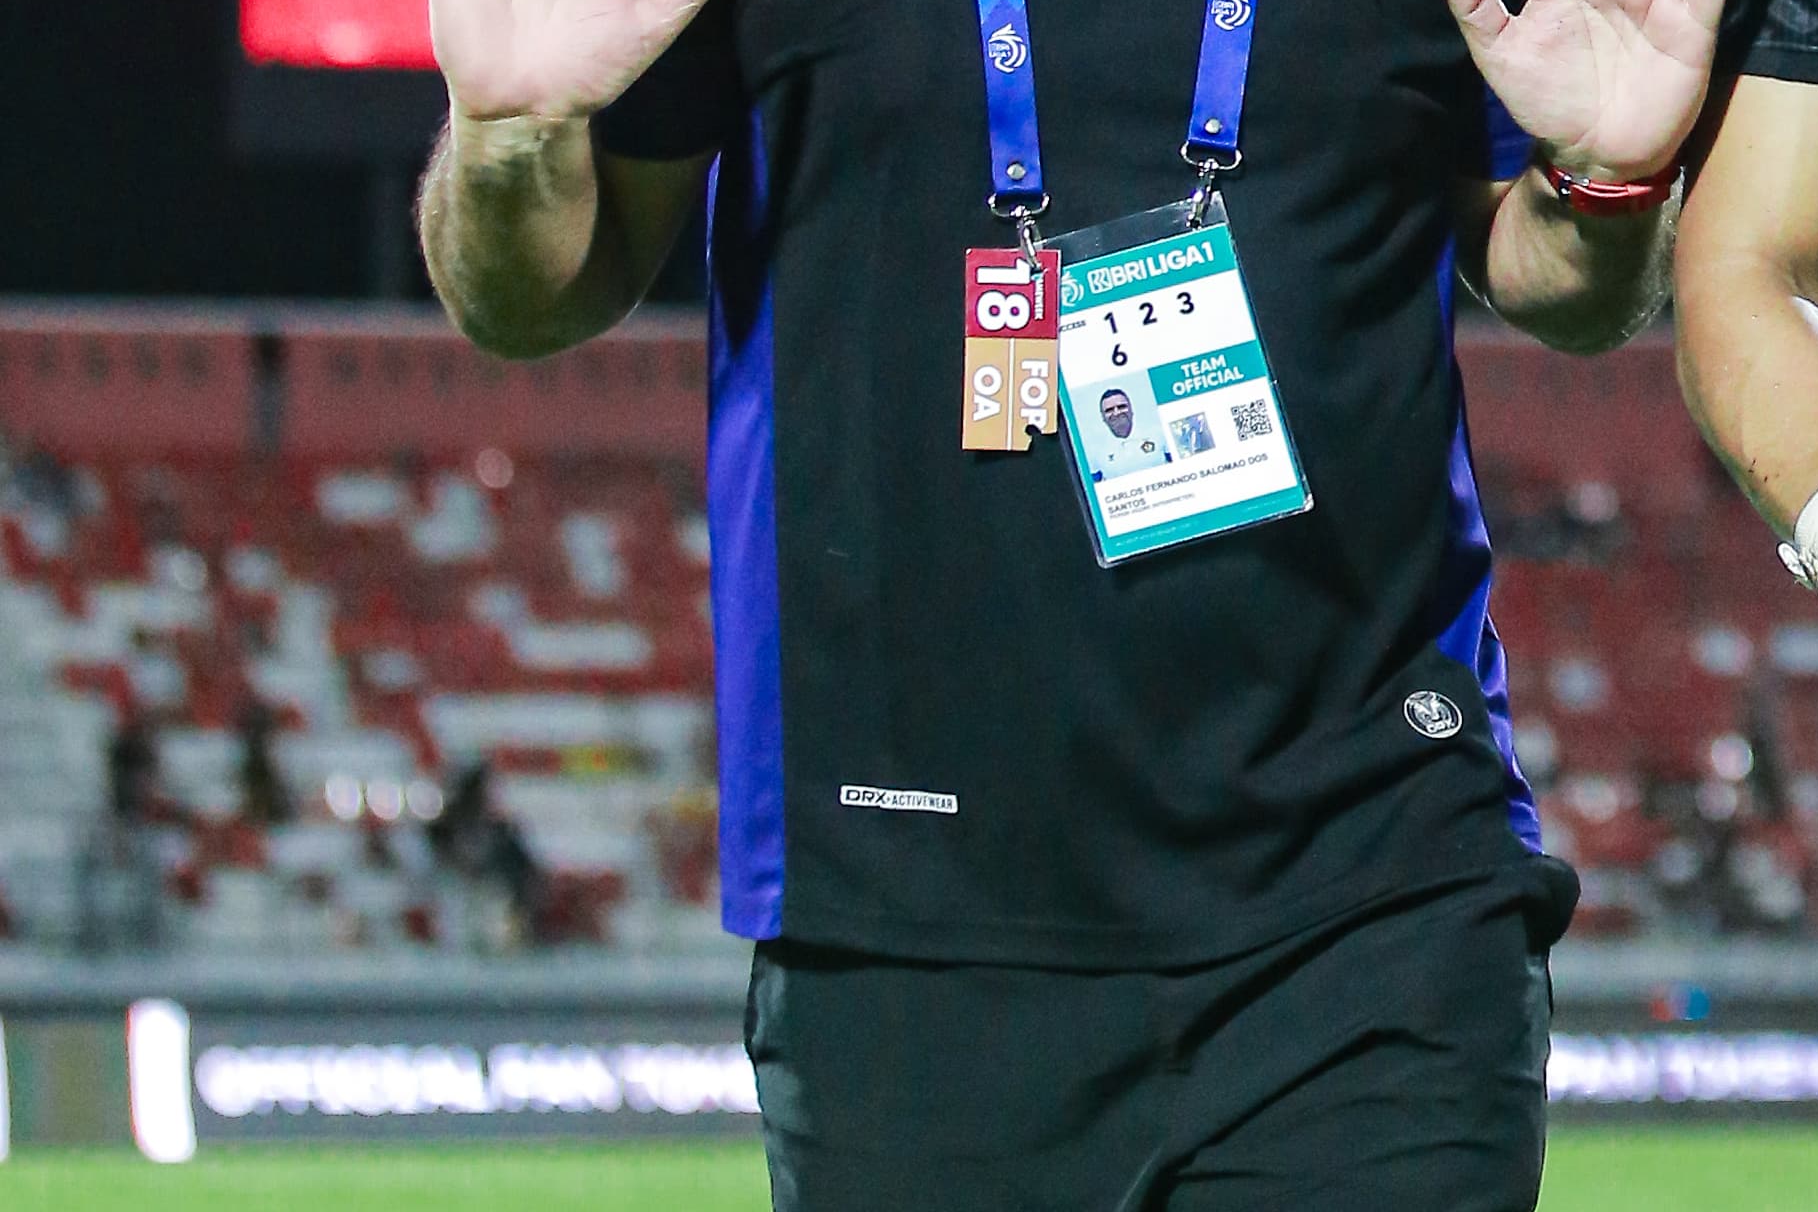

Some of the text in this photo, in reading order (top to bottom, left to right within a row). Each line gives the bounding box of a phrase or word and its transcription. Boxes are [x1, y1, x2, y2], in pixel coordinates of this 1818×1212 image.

[977, 258, 1031, 331] 18
[1104, 292, 1195, 334] 1 2 3
[1111, 343, 1128, 367] 6
[1181, 354, 1227, 378] TEAM
[972, 365, 1002, 421] OA
[1020, 360, 1050, 431] FOP
[1172, 366, 1244, 396] OFFICIAL
[1104, 452, 1269, 504] CARLOS FERNANDO SALOMAO DOS
[1108, 498, 1147, 514] SANTOS
[845, 789, 887, 804] DRX
